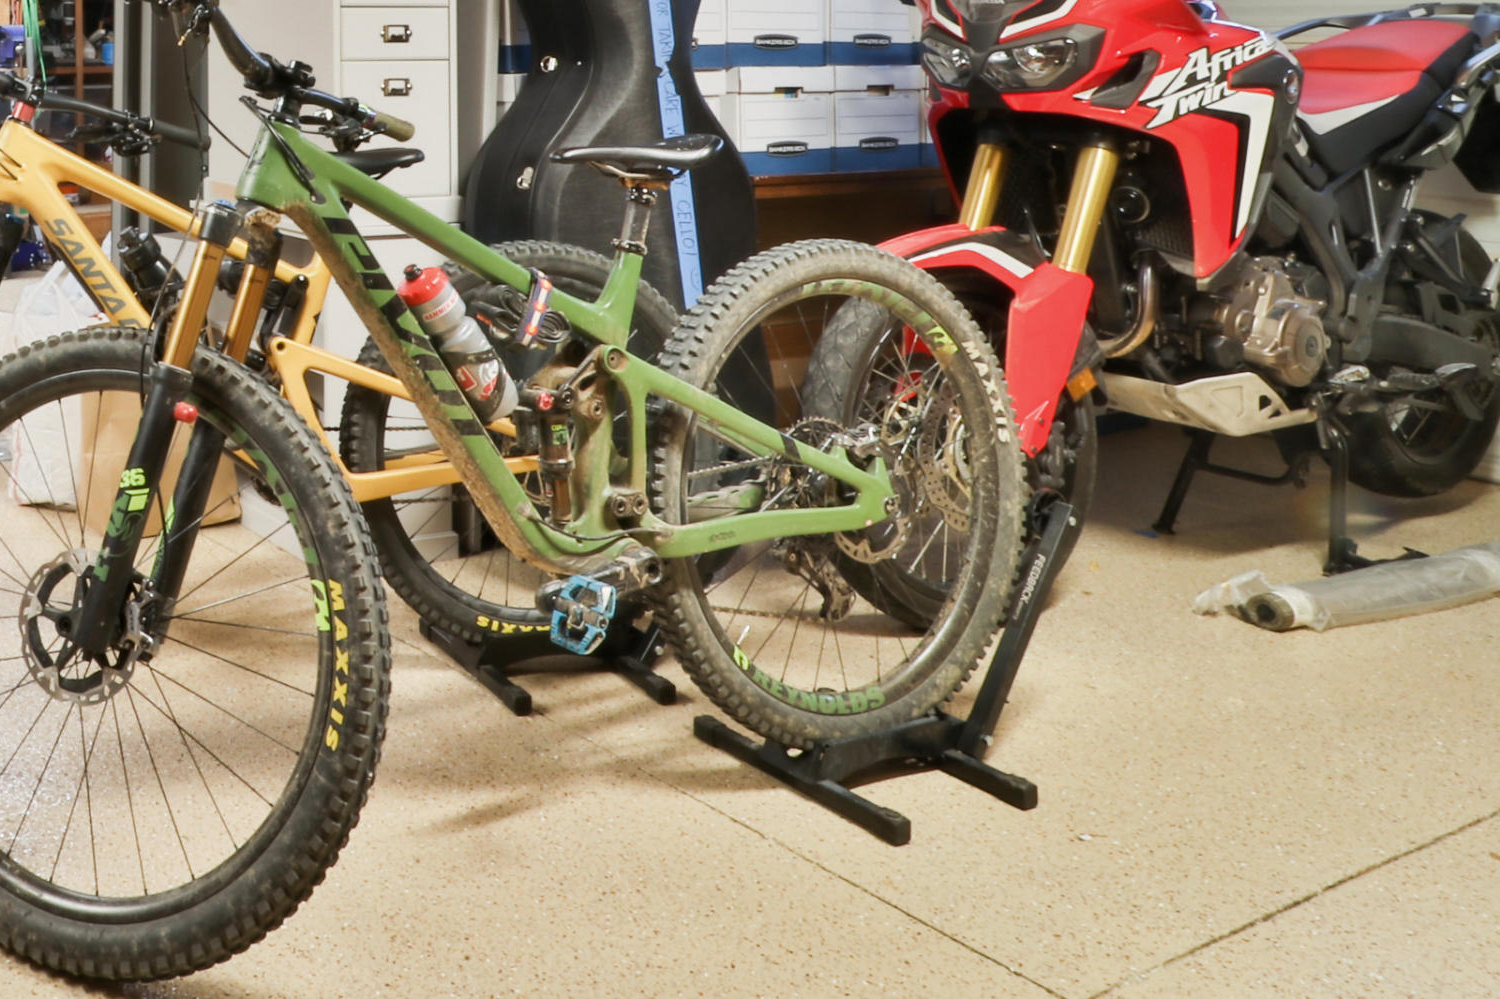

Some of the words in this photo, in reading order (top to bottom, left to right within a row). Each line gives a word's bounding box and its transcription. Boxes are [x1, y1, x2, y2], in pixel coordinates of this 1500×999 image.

[1164, 38, 1274, 96] Africa
[1146, 80, 1238, 129] Twin
[45, 219, 126, 315] SANTA
[961, 341, 1011, 443] MAXXIS
[1022, 553, 1046, 606] FEEDBACK
[325, 578, 349, 752] MAXXIS
[750, 662, 886, 716] REYNOLDS
